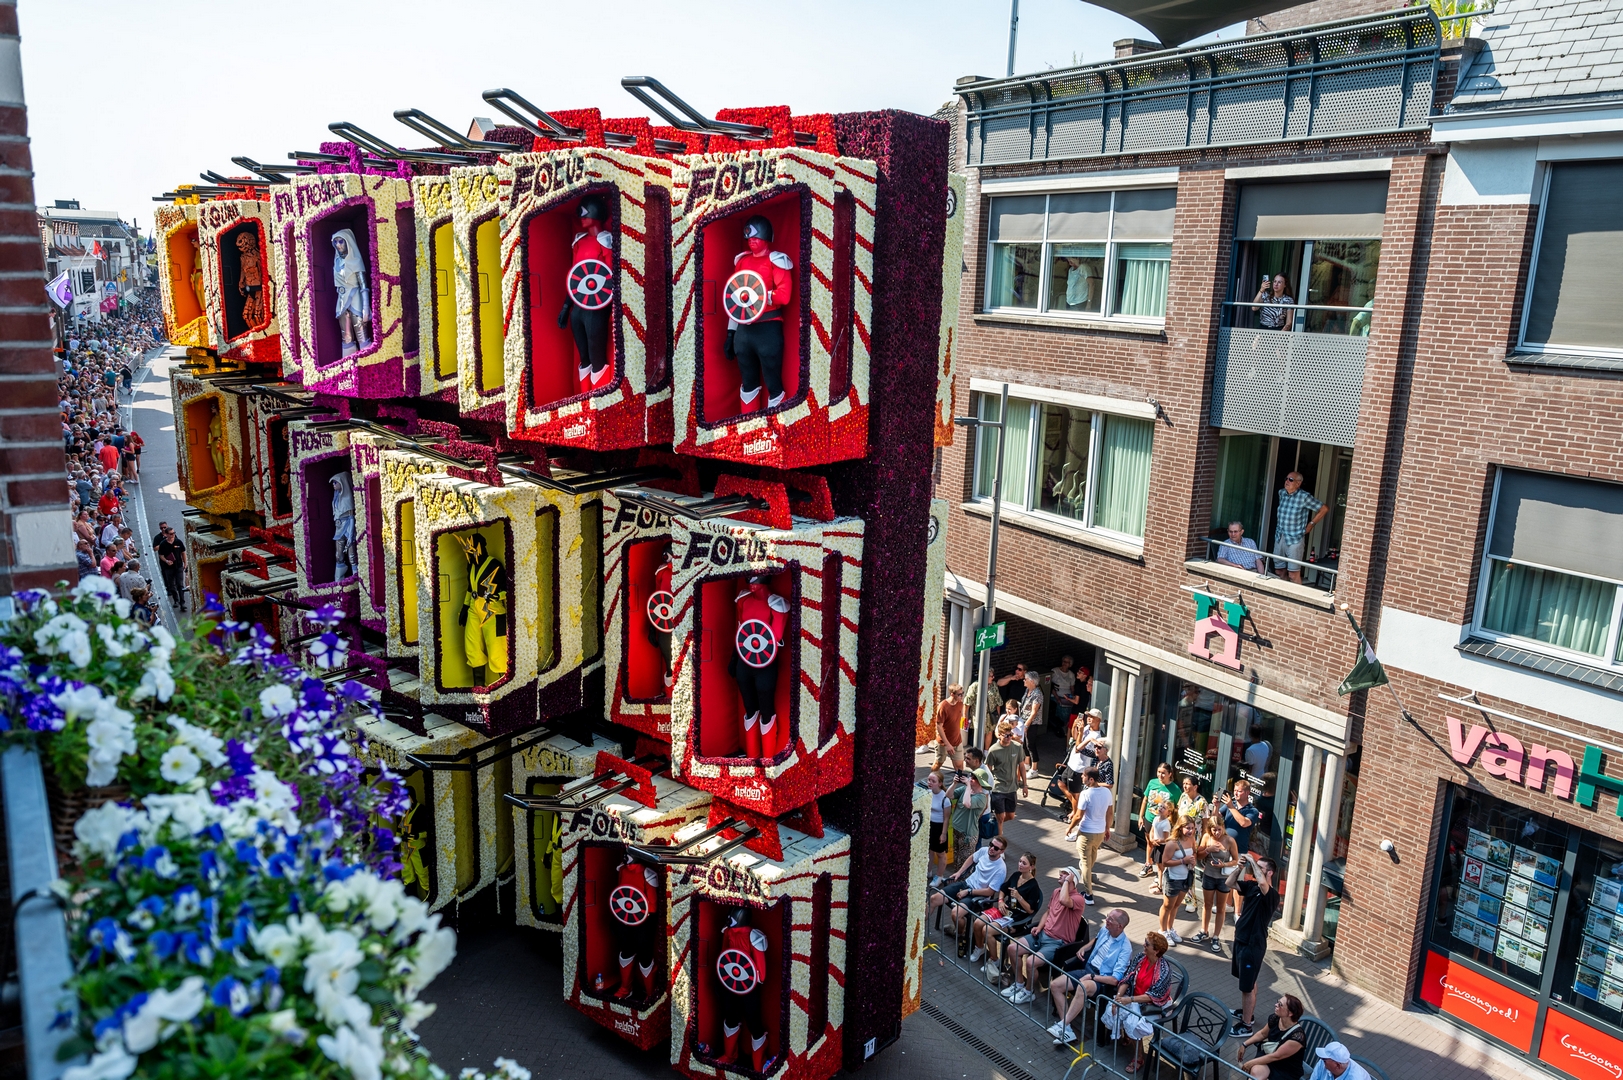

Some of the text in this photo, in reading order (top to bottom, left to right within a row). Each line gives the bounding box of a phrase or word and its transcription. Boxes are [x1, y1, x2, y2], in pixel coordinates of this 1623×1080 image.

[457, 172, 500, 213] VO
[510, 156, 584, 211] FOCUS
[683, 158, 777, 216] FOCUS
[563, 424, 587, 439] helden
[743, 438, 772, 456] helden
[612, 500, 672, 533] FOC
[681, 531, 768, 570] FOCUS
[657, 721, 672, 733] held
[734, 785, 761, 801] helden
[569, 808, 637, 842] FOCUS
[1439, 975, 1519, 1023] Gewoongoed!
[1560, 1034, 1623, 1079] Gewoong
